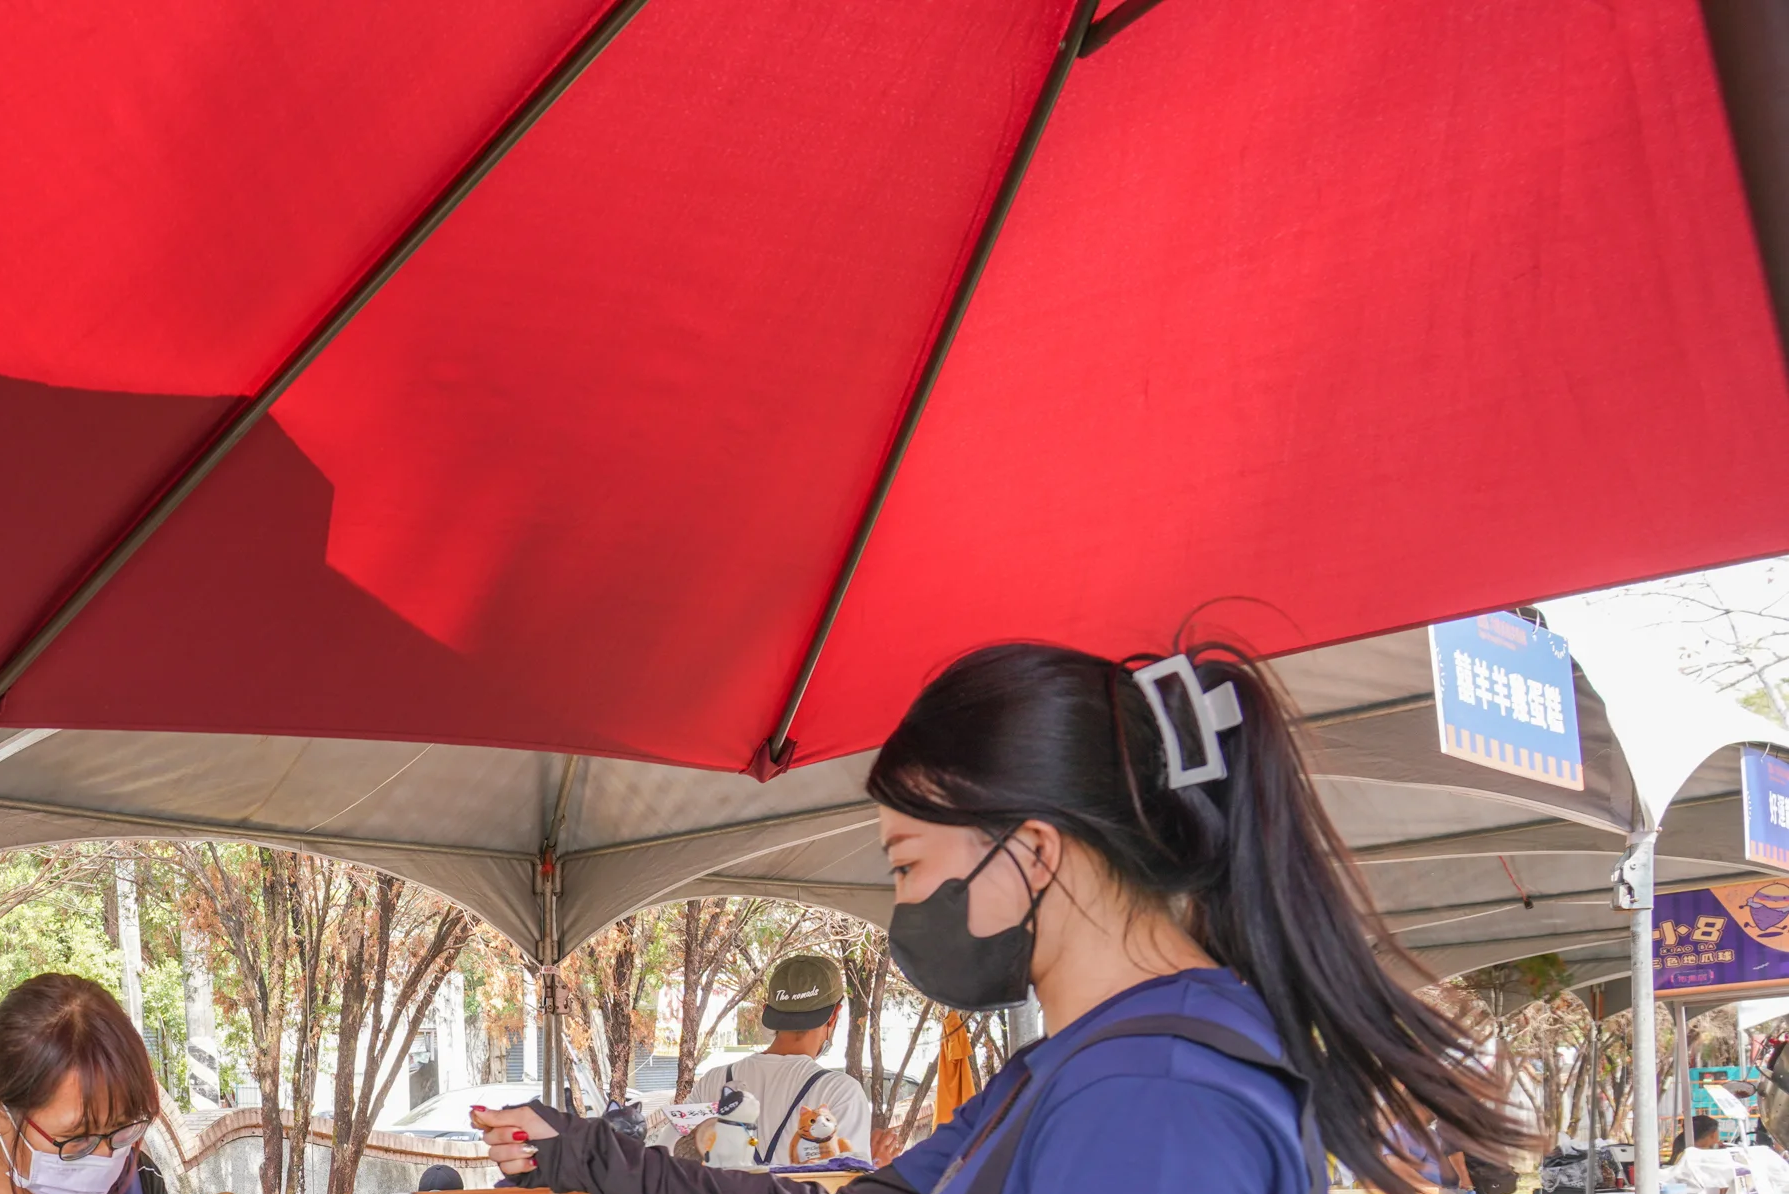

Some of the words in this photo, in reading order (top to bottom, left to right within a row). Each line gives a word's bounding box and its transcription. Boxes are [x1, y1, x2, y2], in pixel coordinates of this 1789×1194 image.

[1660, 945, 1693, 955] XIAO
[1698, 942, 1716, 951] BA
[776, 989, 790, 1002] The
[791, 985, 820, 1001] nomads
